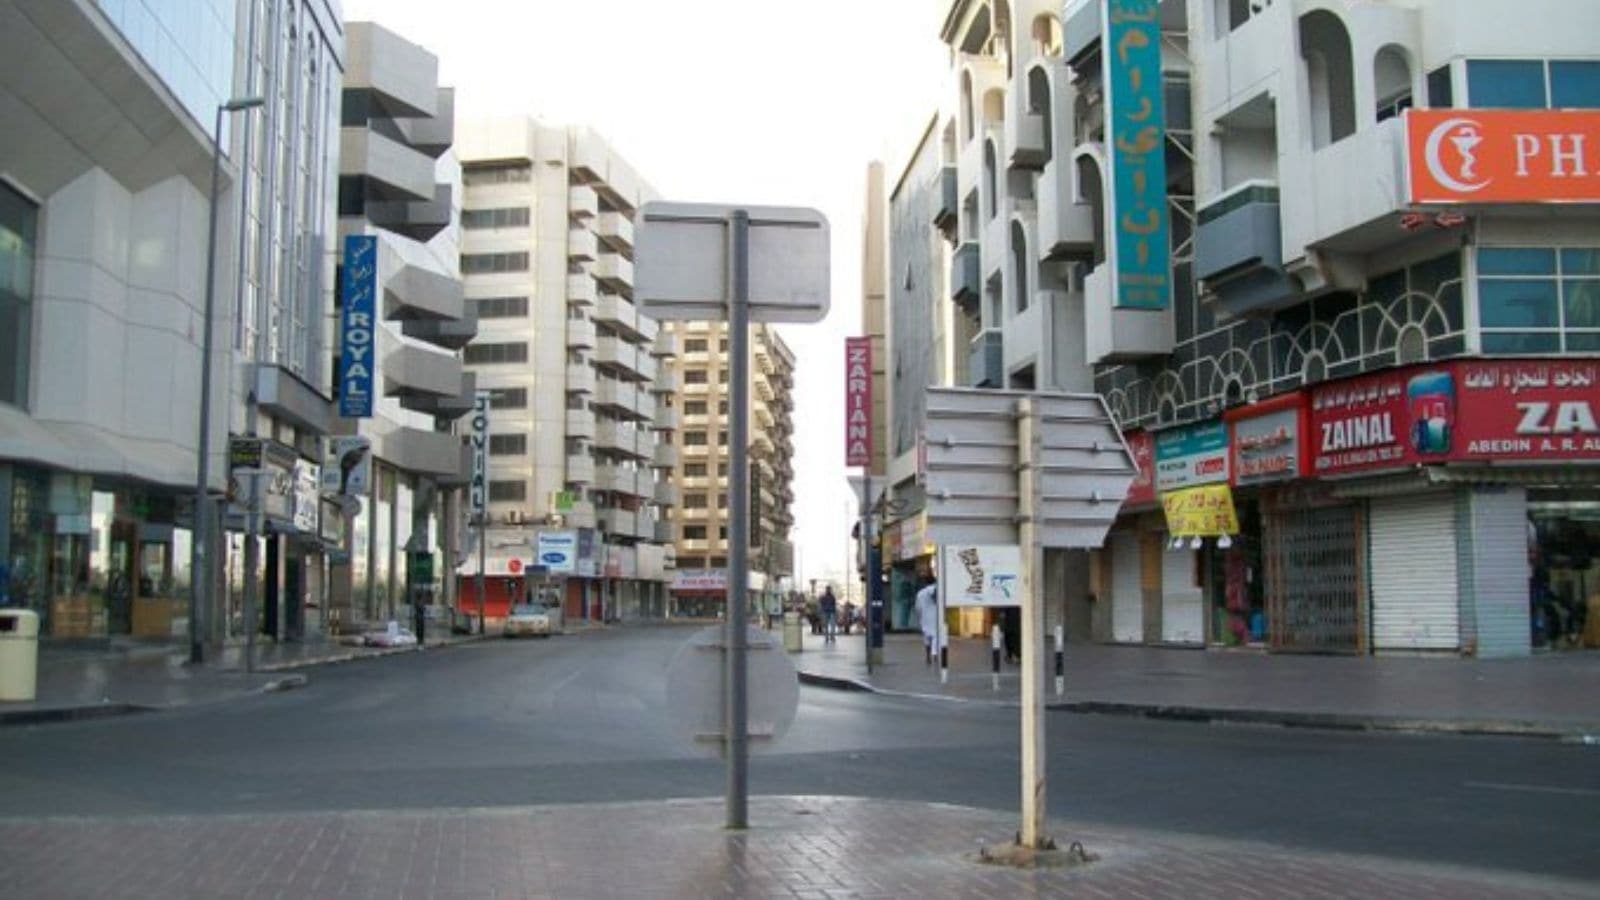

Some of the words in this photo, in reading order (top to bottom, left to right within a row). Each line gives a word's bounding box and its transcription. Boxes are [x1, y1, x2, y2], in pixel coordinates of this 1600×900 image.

[1513, 133, 1600, 177] PH
[346, 312, 371, 395] ROYAL
[848, 346, 867, 456] ZARIANA
[1514, 401, 1600, 434] ZA
[472, 397, 487, 508] JOVIAL
[1321, 411, 1396, 451] ZAINAL
[1468, 440, 1530, 453] ABEDIN
